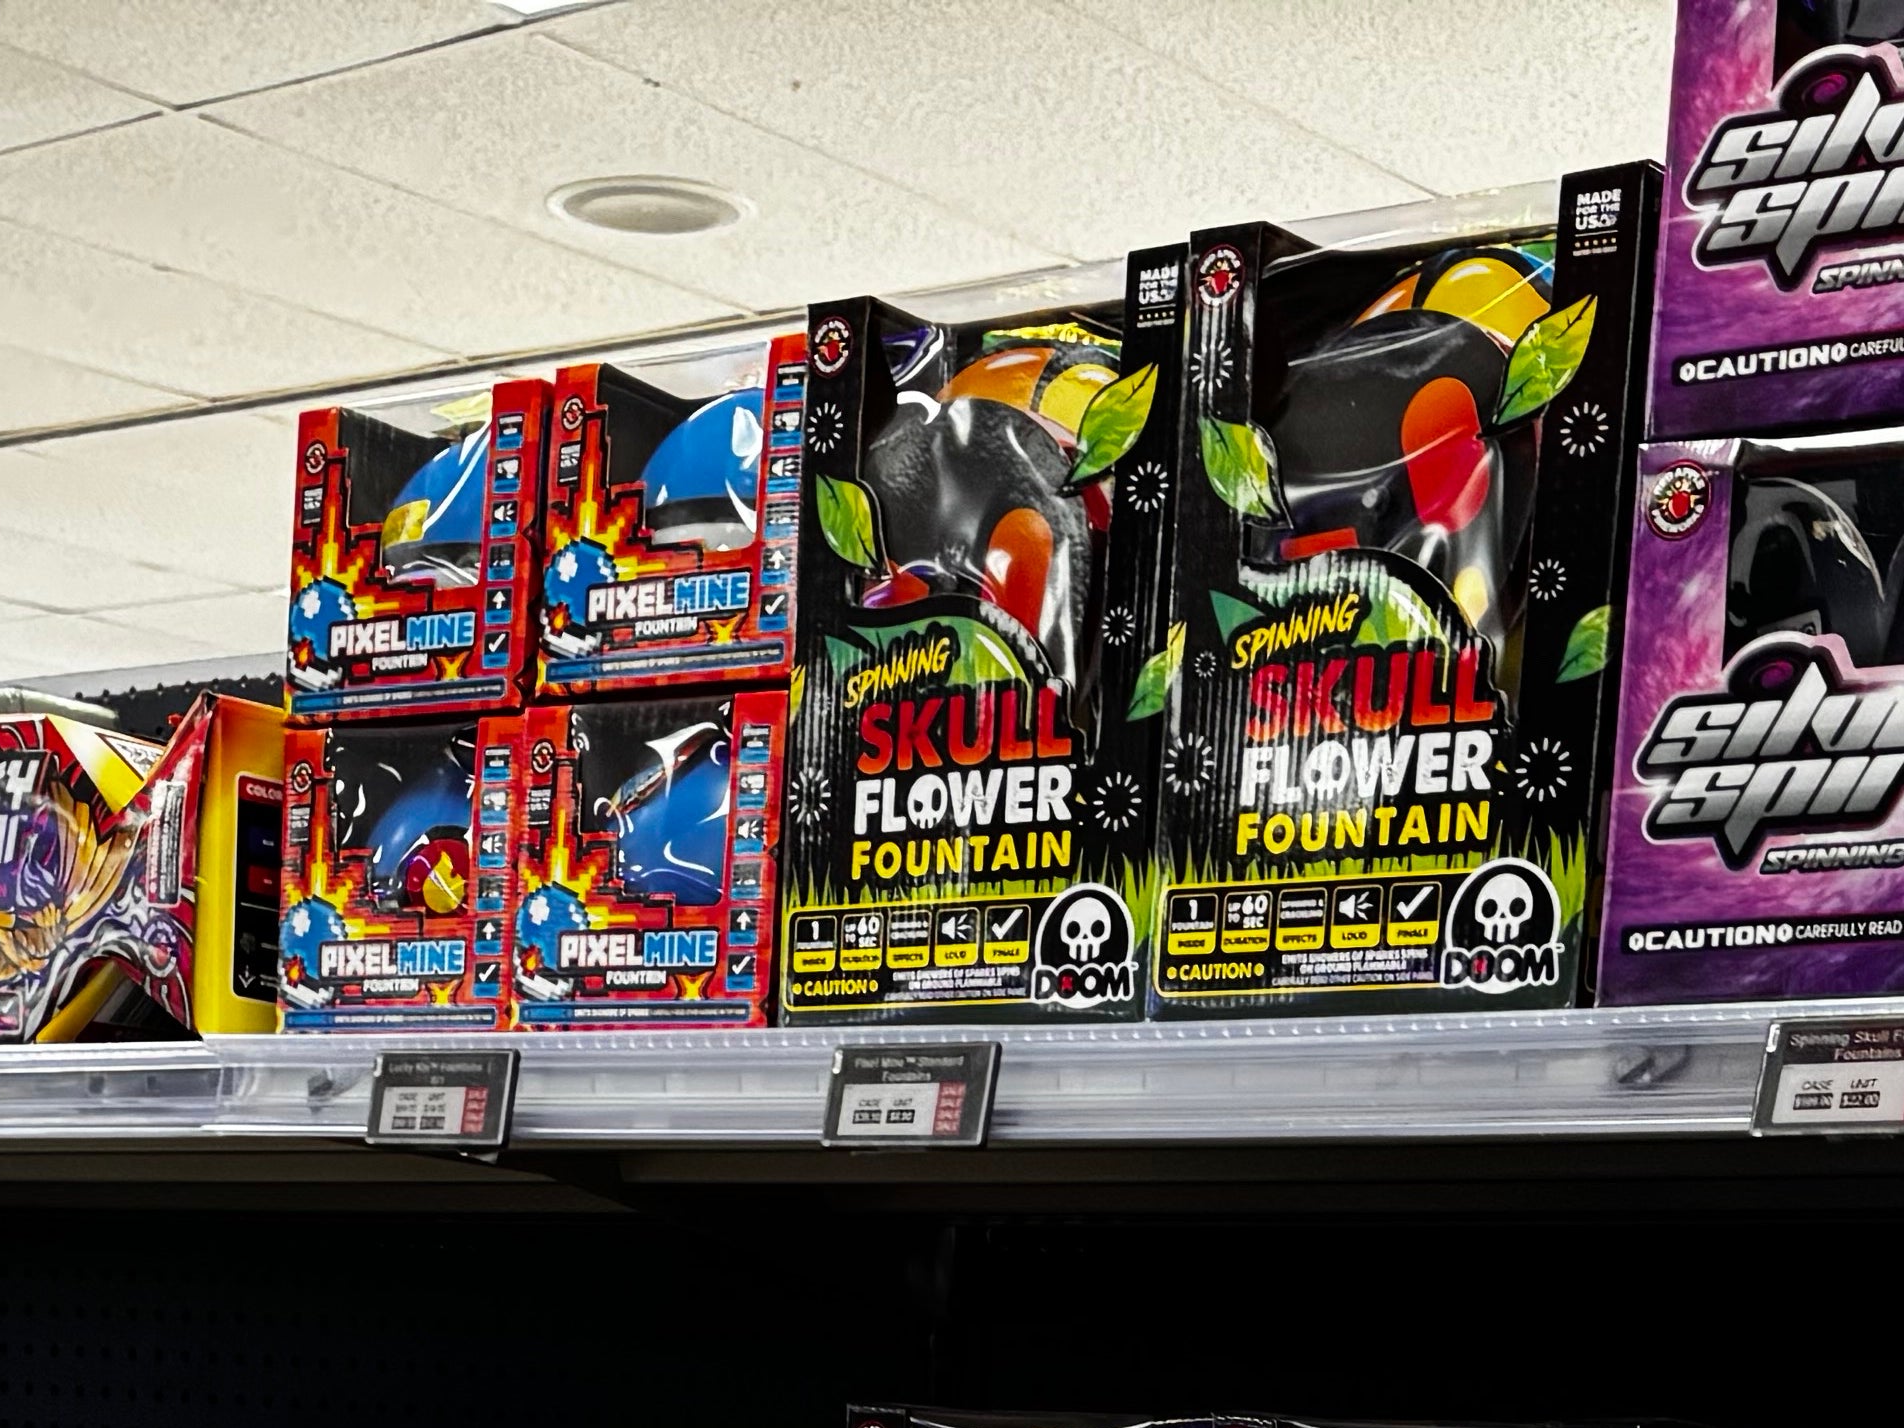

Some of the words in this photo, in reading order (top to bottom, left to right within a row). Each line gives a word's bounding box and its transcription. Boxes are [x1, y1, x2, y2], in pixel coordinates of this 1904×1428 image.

[635, 618, 698, 635] FOUNTAIN
[1230, 592, 1361, 670] SPINNING
[844, 636, 950, 711] SPINNING
[1247, 644, 1496, 742] SKULL
[856, 681, 1073, 775] SKULL
[854, 765, 1073, 837] FLOWER
[1240, 731, 1494, 805] FLOWER
[850, 829, 1073, 883] FOUNTAIN
[1236, 802, 1491, 857] FOUNTAIN
[1444, 946, 1561, 987] DOOM
[1790, 1033, 1850, 1047] Spinning
[1854, 1030, 1889, 1043] Skull
